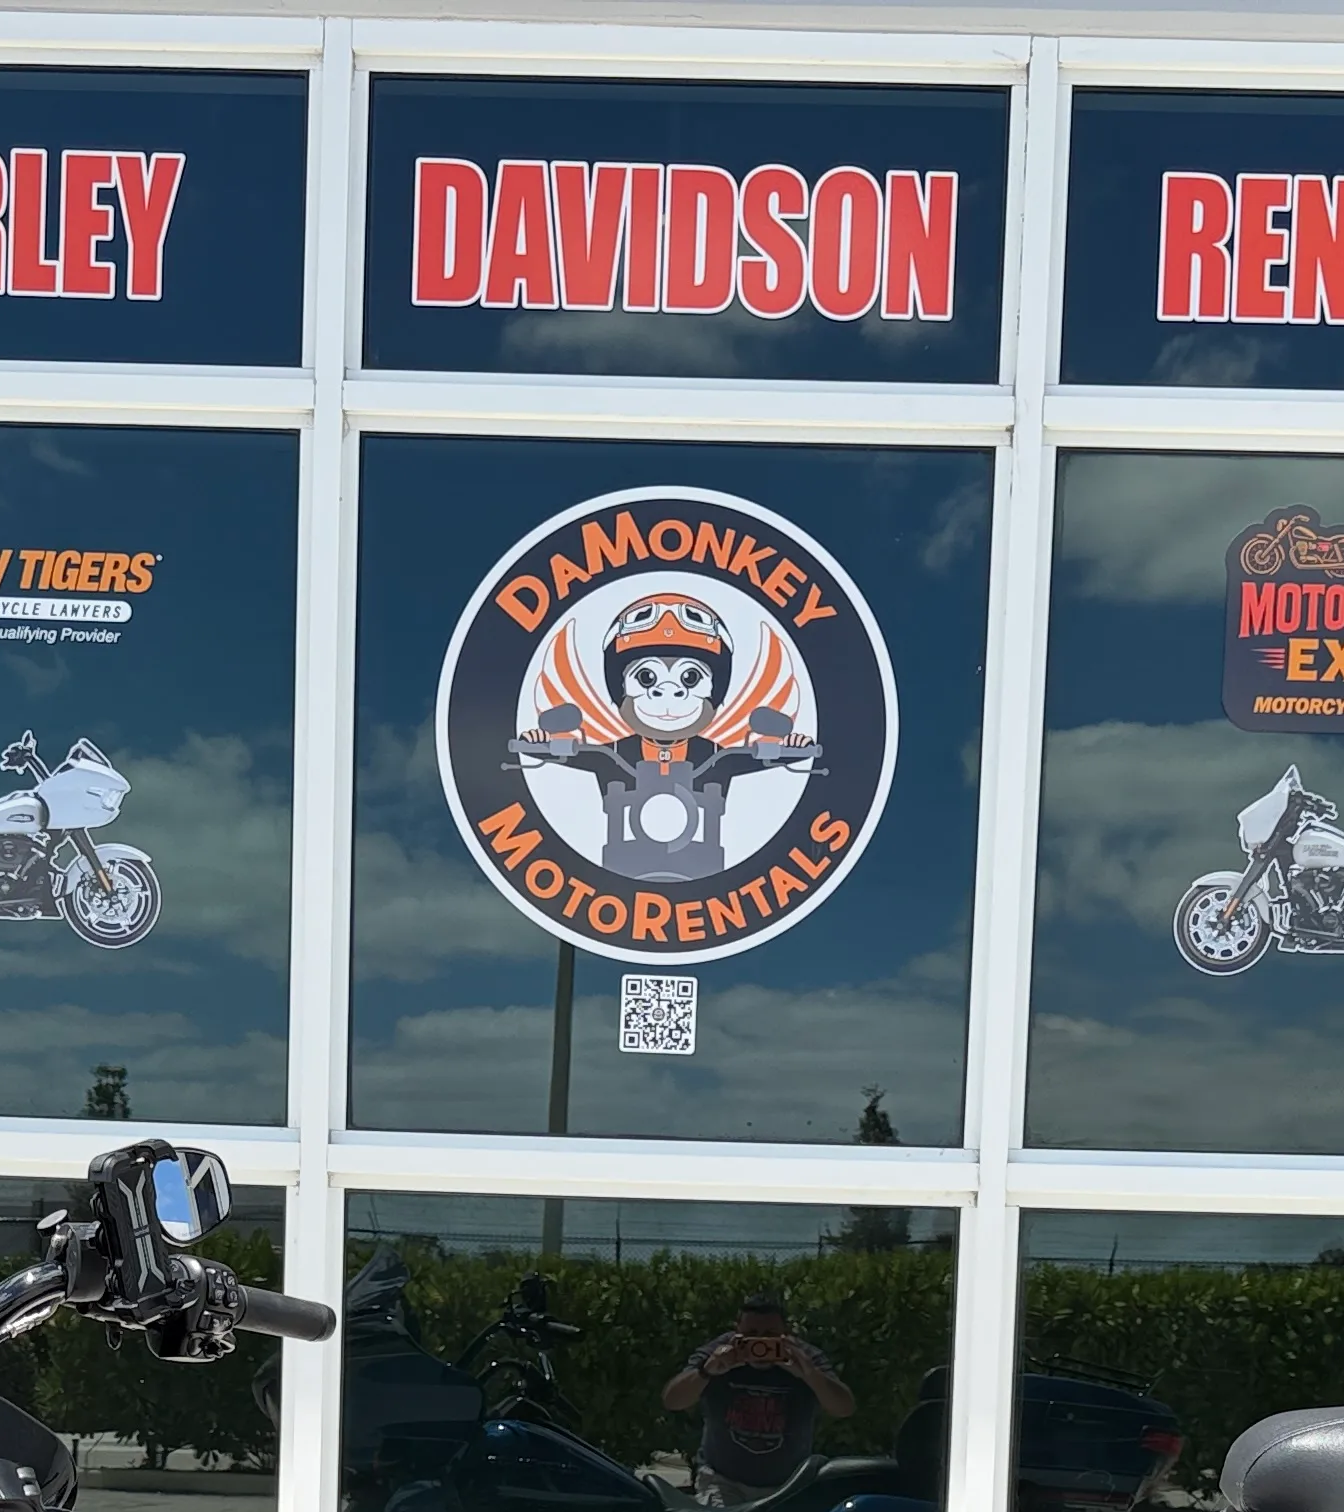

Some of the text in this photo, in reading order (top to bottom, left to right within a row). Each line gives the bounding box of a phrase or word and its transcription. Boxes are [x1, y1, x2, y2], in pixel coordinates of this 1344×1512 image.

[411, 157, 958, 321] DAVIDSON
[49, 603, 123, 619] LAWYERS
[60, 627, 122, 644] Provider
